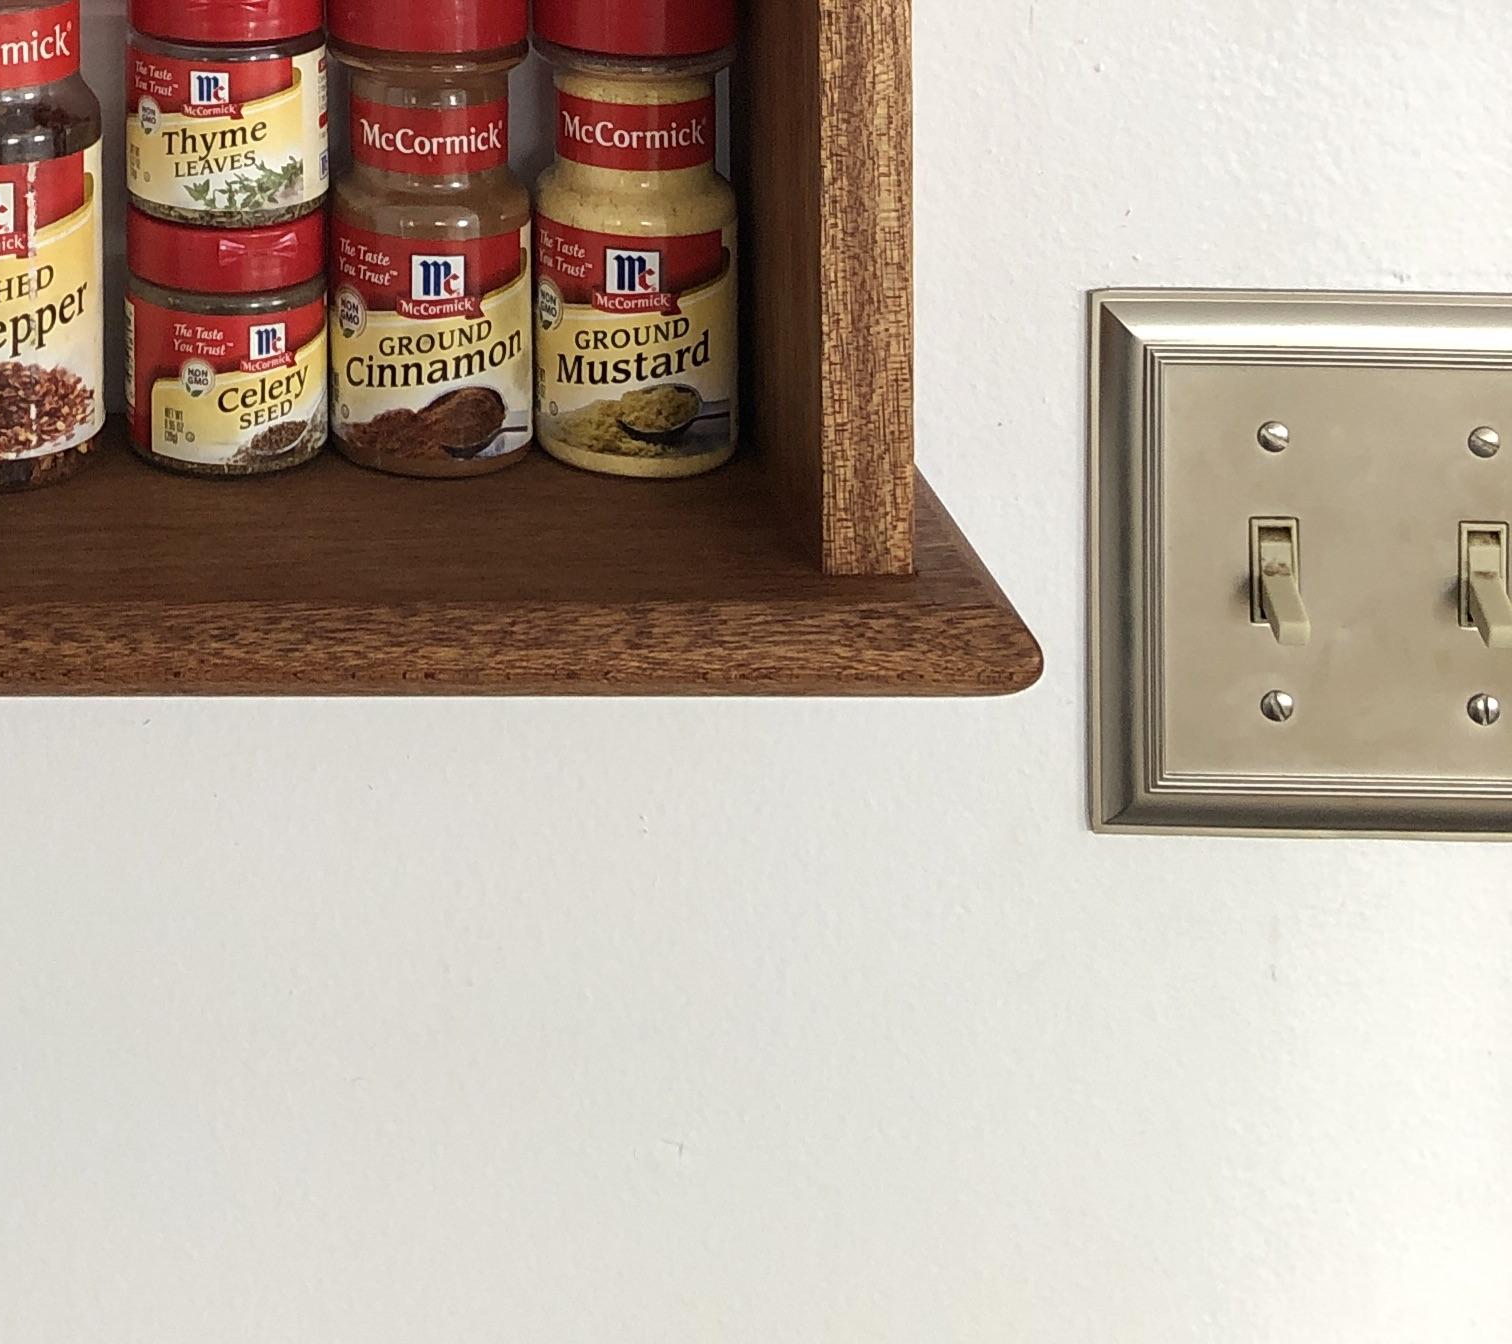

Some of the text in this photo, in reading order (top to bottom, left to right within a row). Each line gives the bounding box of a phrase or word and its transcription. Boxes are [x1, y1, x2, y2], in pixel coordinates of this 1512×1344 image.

[184, 104, 236, 116] McCormick
[162, 121, 267, 161] Thyme
[360, 119, 502, 155] McCormick
[562, 111, 704, 149] McCormick
[175, 150, 256, 178] LEAVES
[358, 245, 390, 265] Taste
[400, 299, 473, 315] McCormick
[596, 292, 669, 310] McCormick
[173, 339, 192, 352] You
[174, 324, 223, 341] The Taste
[379, 320, 491, 357] GROUND
[575, 317, 689, 350] GROUND
[346, 330, 522, 388] Cinnamon
[556, 330, 710, 385] Mustard
[188, 368, 207, 377] NON
[188, 377, 208, 386] GMO
[218, 365, 308, 413] Celery
[240, 399, 292, 429] SEED
